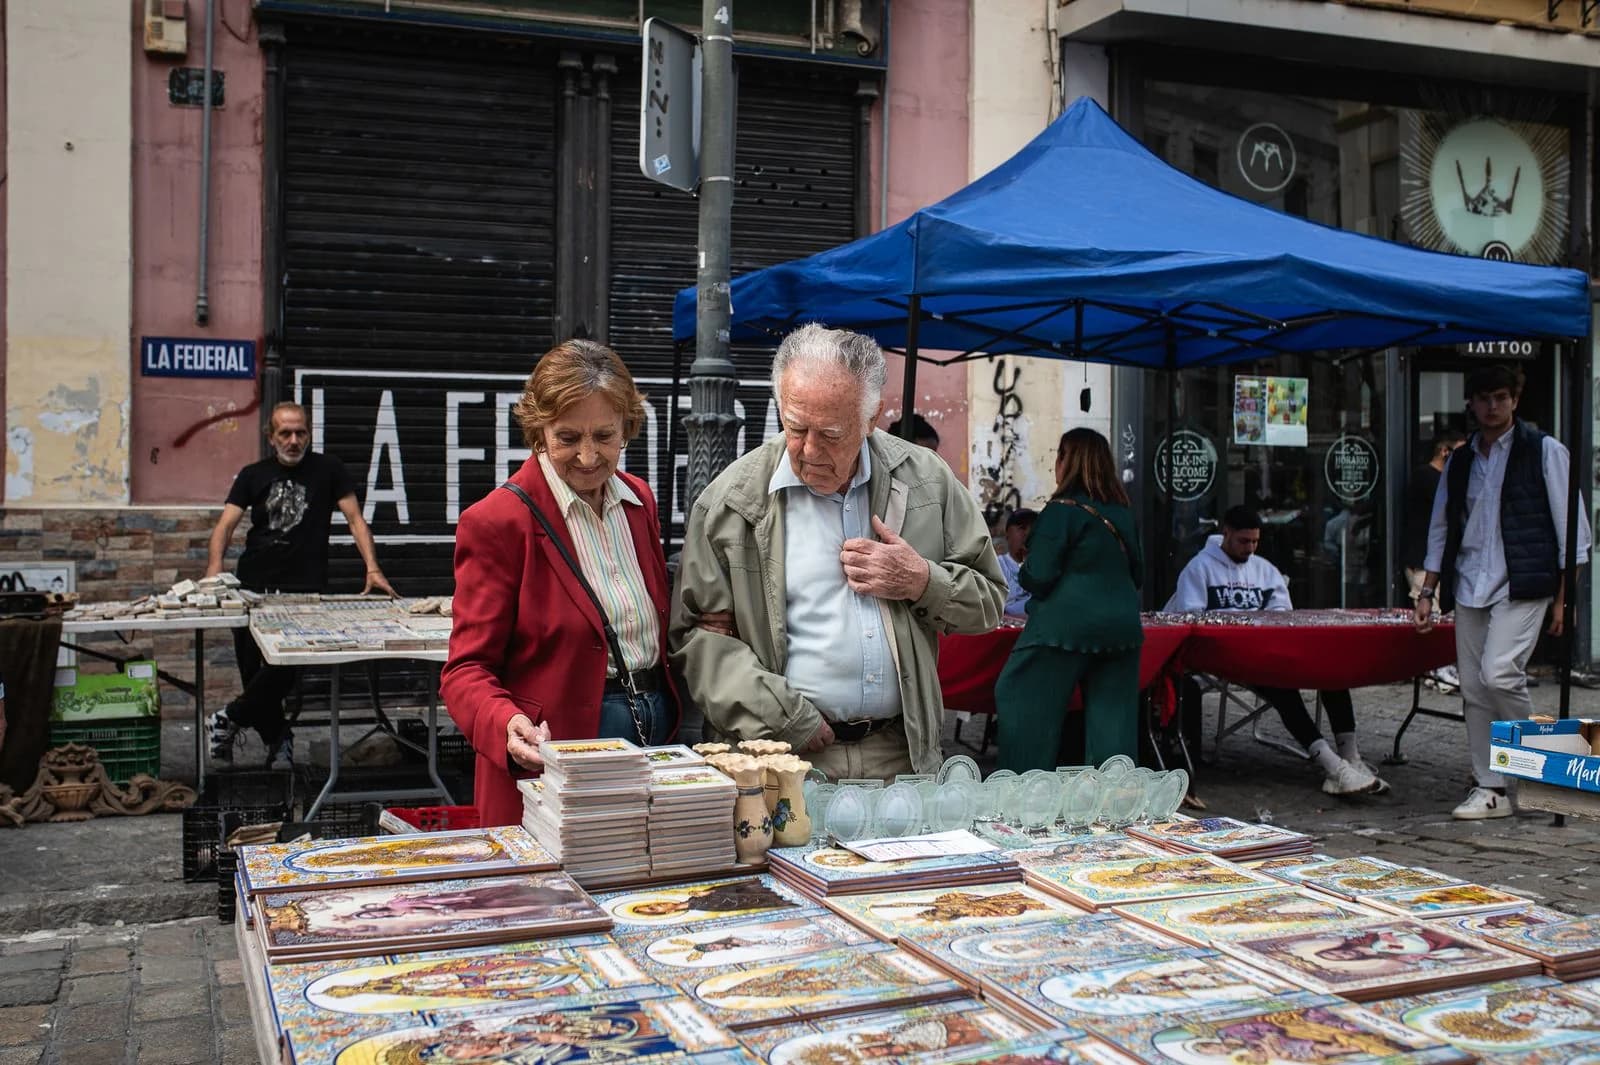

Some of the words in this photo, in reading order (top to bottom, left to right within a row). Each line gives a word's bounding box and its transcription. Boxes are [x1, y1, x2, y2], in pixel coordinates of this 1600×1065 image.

[714, 6, 729, 24] 4
[147, 343, 171, 369] LA
[173, 343, 249, 372] FEDERAL
